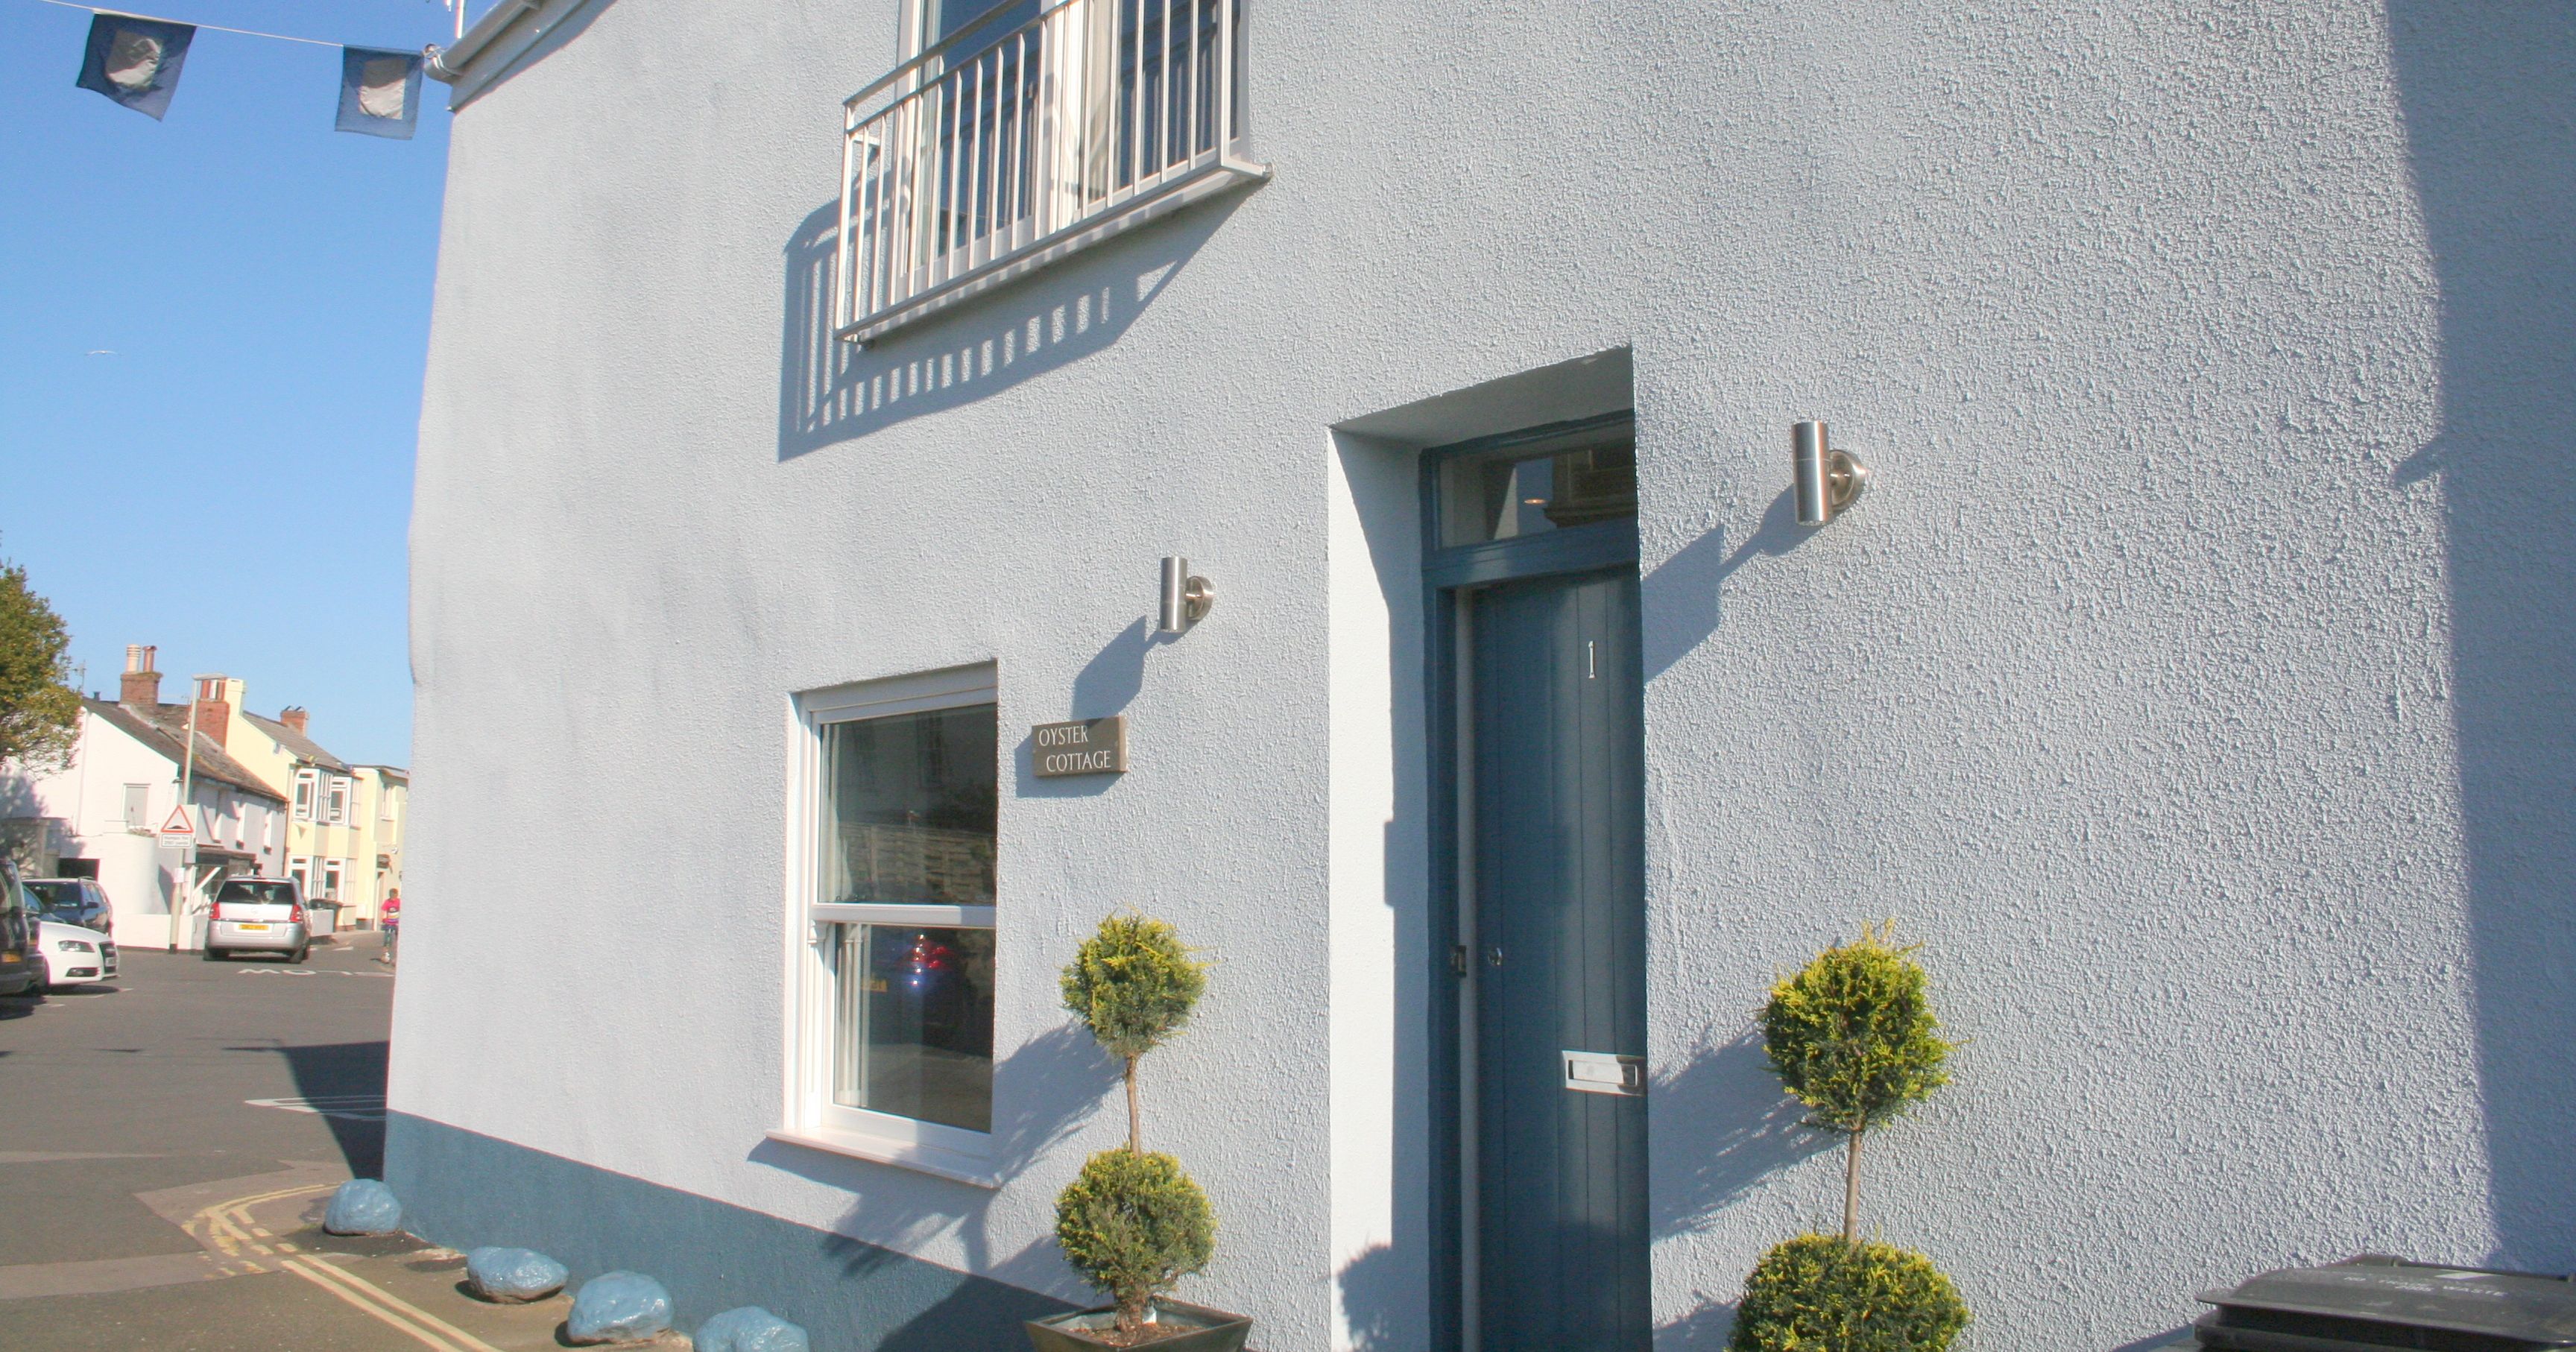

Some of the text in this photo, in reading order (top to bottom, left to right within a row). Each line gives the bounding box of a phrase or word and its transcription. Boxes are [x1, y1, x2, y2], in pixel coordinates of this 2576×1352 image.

[1588, 640, 1596, 679] 1
[1038, 725, 1088, 747] OYSTER
[1046, 751, 1111, 772] COTTAGE
